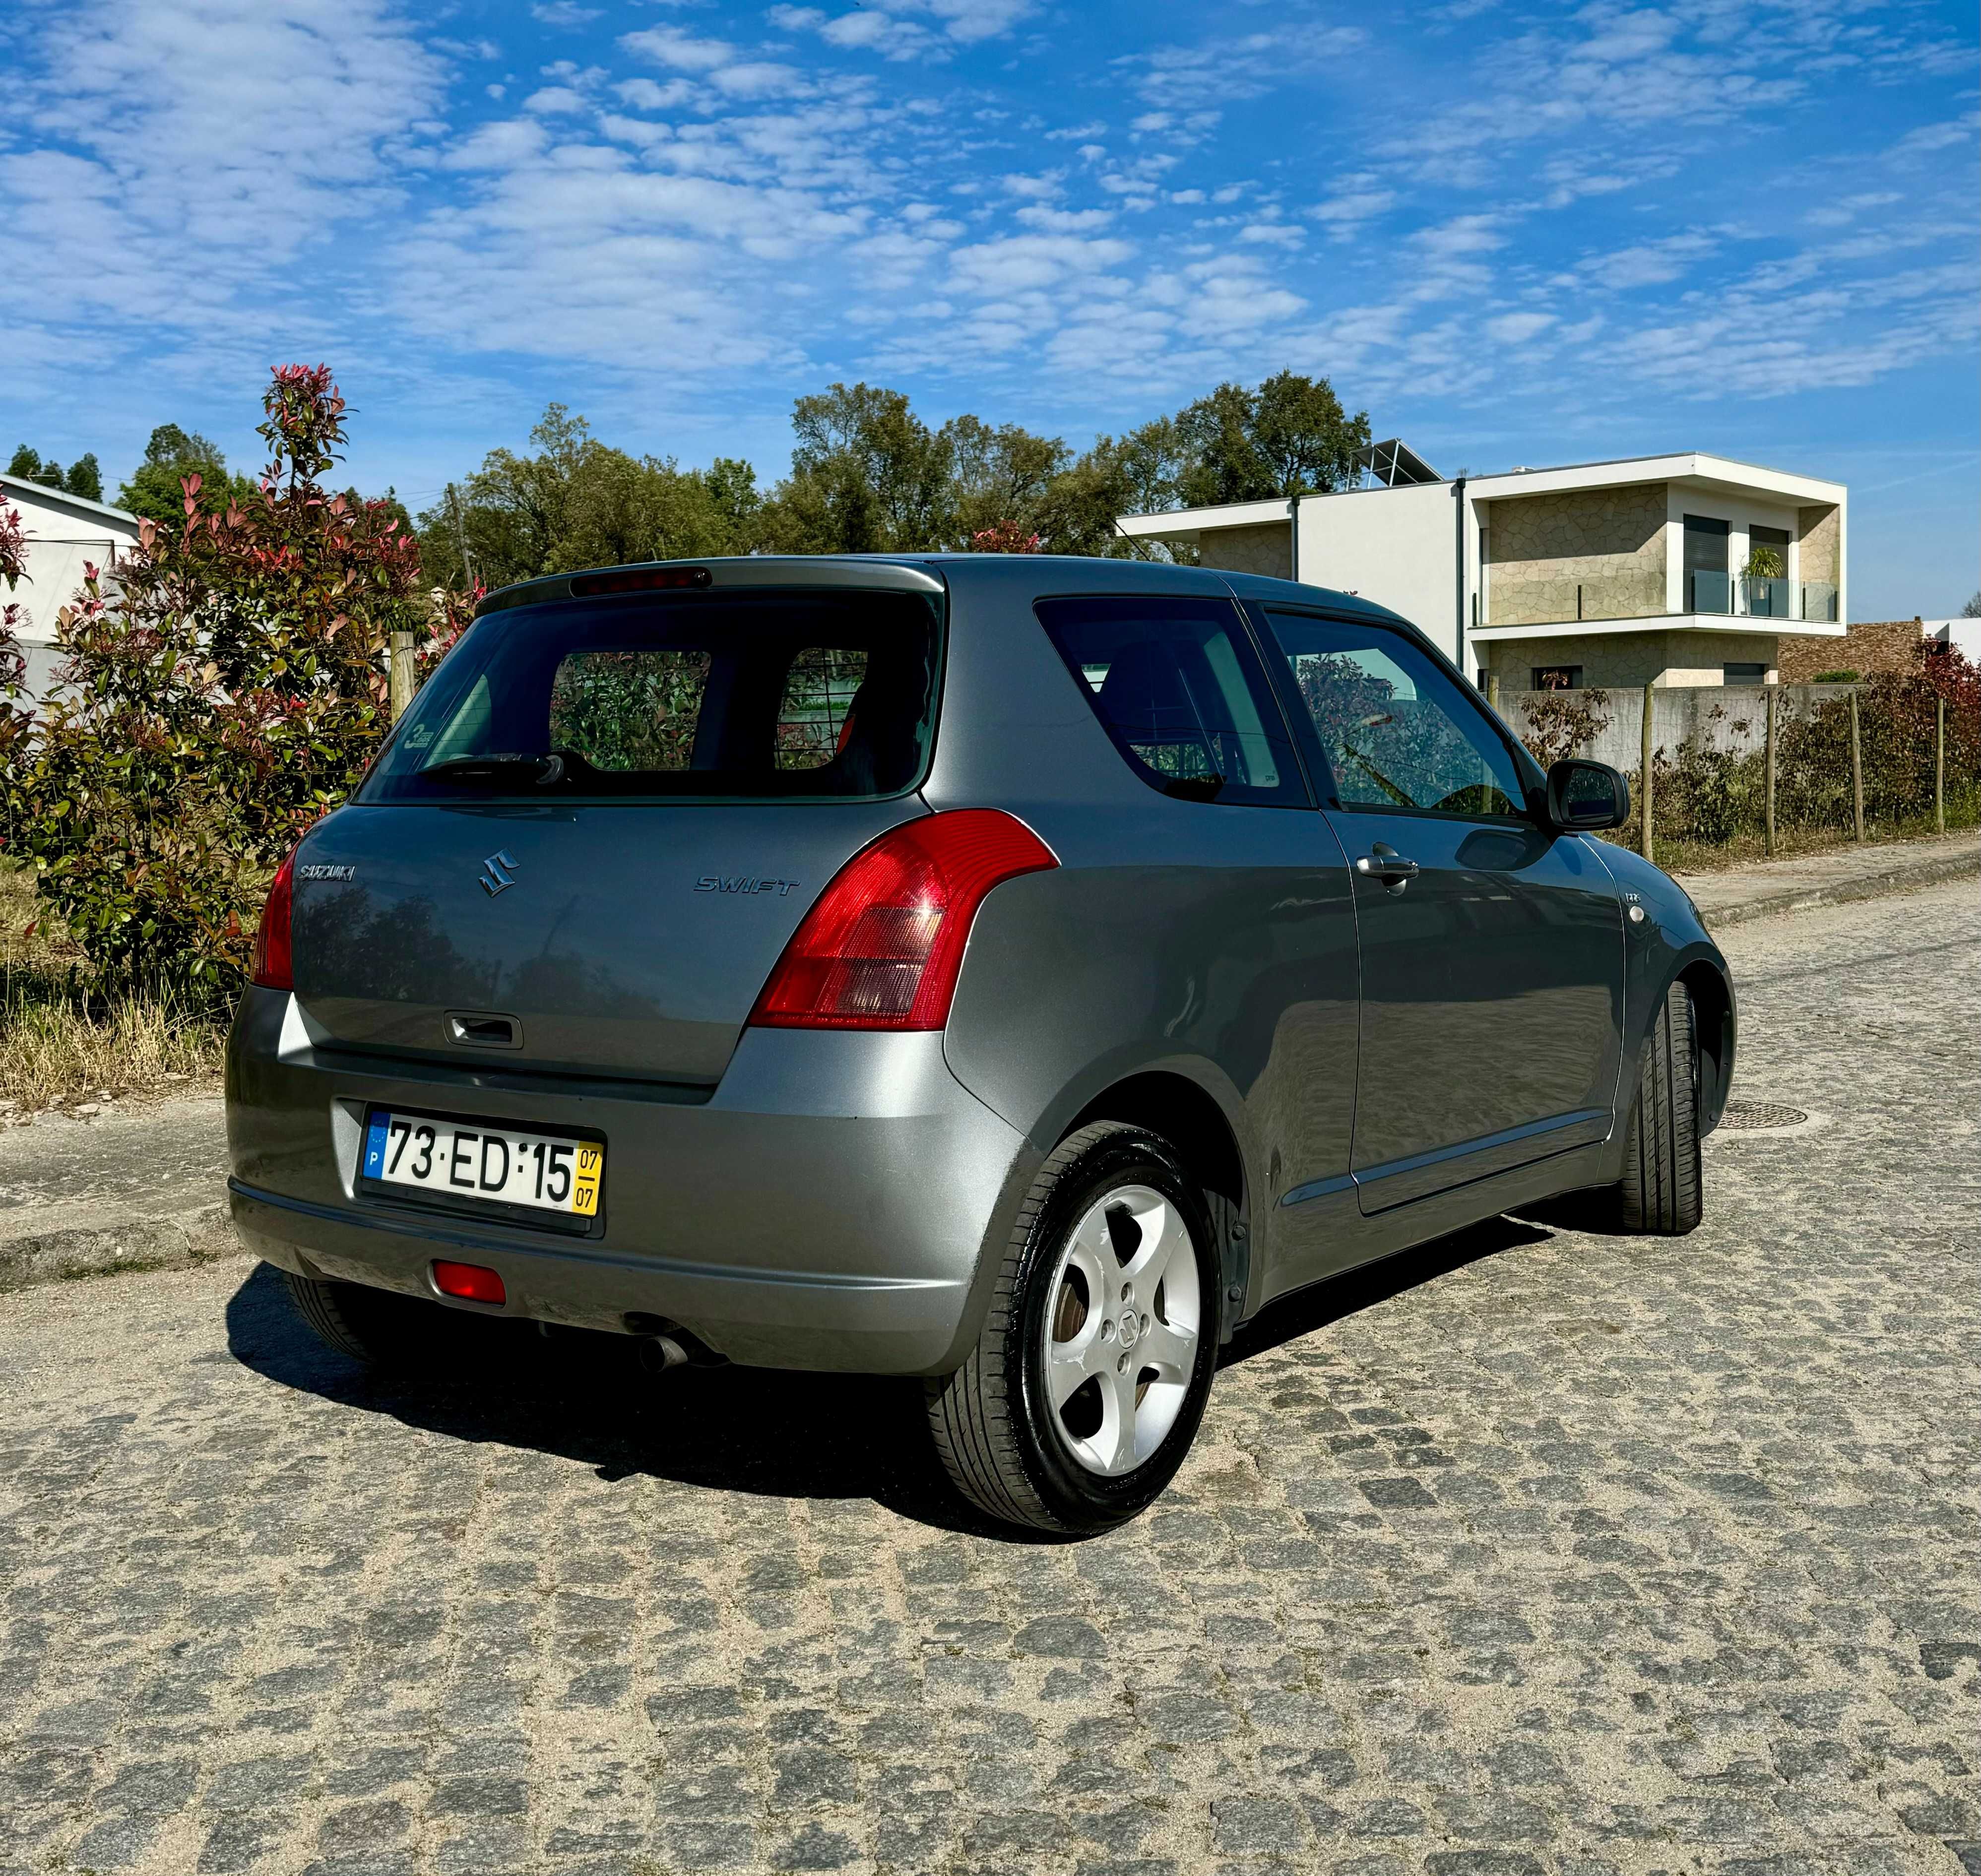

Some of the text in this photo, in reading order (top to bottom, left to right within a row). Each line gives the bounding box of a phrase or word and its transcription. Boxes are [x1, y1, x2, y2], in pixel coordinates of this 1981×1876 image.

[300, 865, 355, 881] SUZUKI
[693, 876, 801, 896] SWIFT
[370, 1151, 378, 1166] P
[580, 1149, 598, 1170] 07
[575, 1187, 593, 1208] 07
